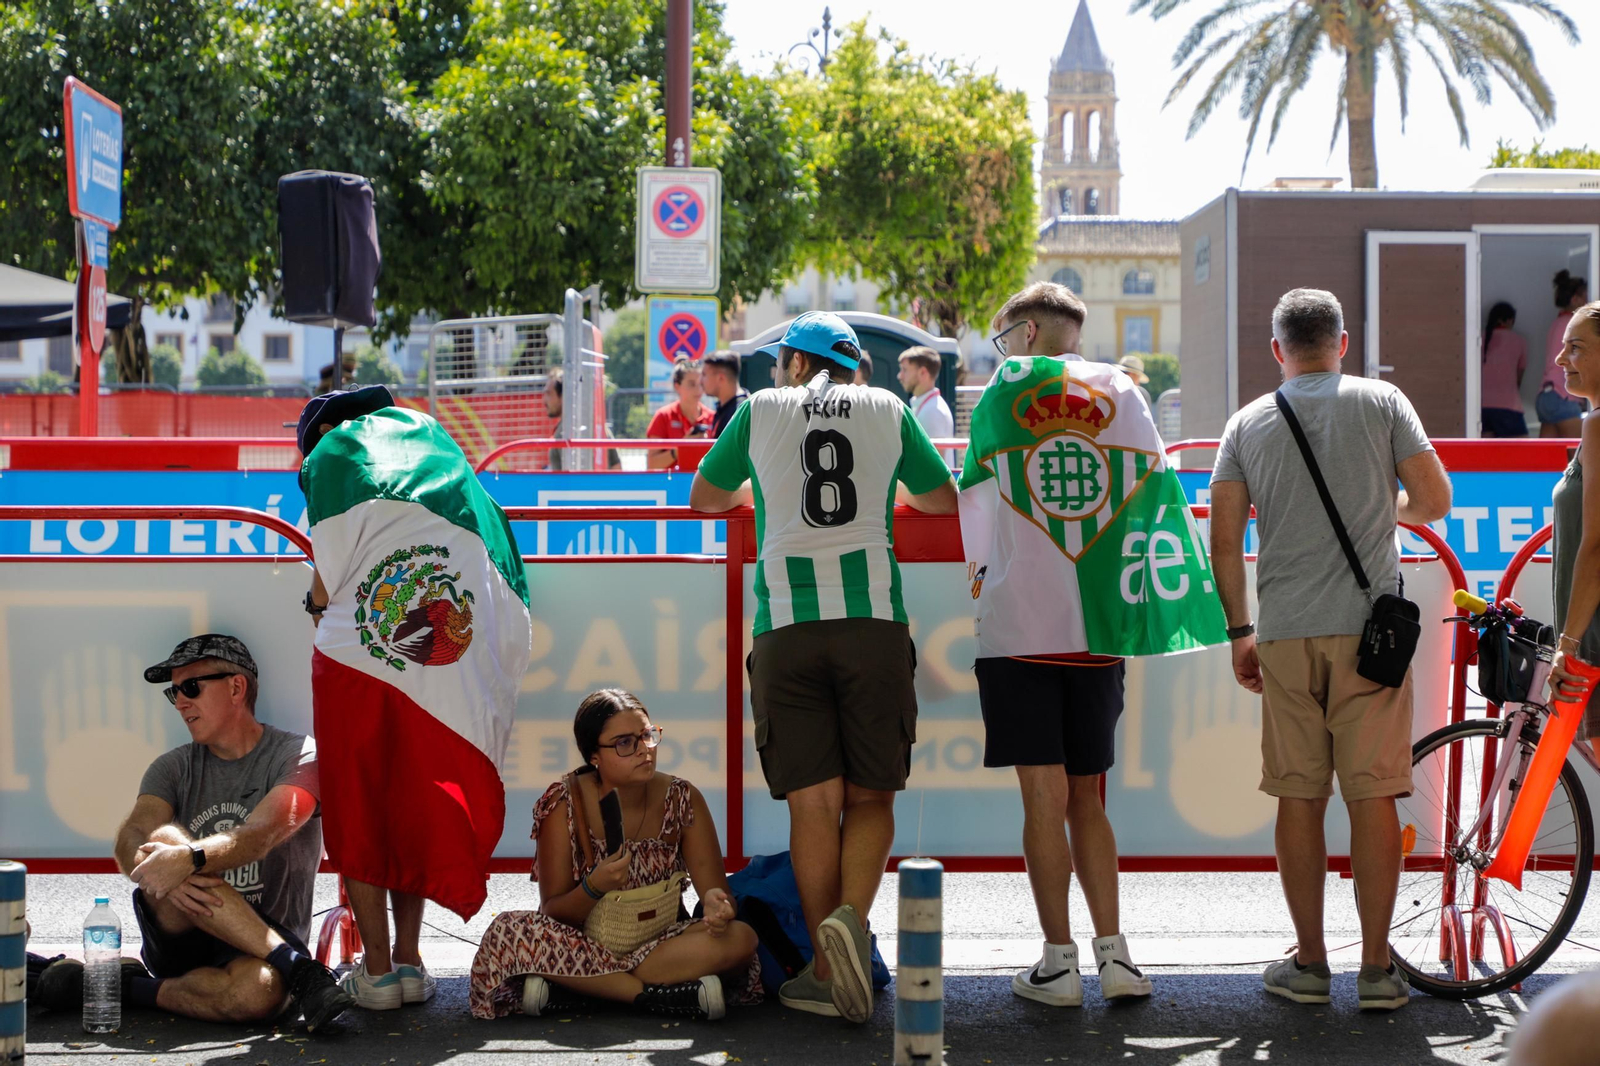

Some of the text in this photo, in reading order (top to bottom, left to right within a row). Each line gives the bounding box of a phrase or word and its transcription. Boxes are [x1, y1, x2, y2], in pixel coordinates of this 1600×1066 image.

[92, 127, 119, 163] LOTERÍAS
[92, 286, 105, 323] 125
[802, 397, 852, 423] FEKIR
[800, 429, 858, 528] 8
[189, 804, 220, 833] BROOKS
[220, 802, 248, 819] RUNNG
[224, 861, 259, 887] AGO
[1063, 951, 1077, 960] NIKE
[1100, 943, 1116, 952] NIKE
